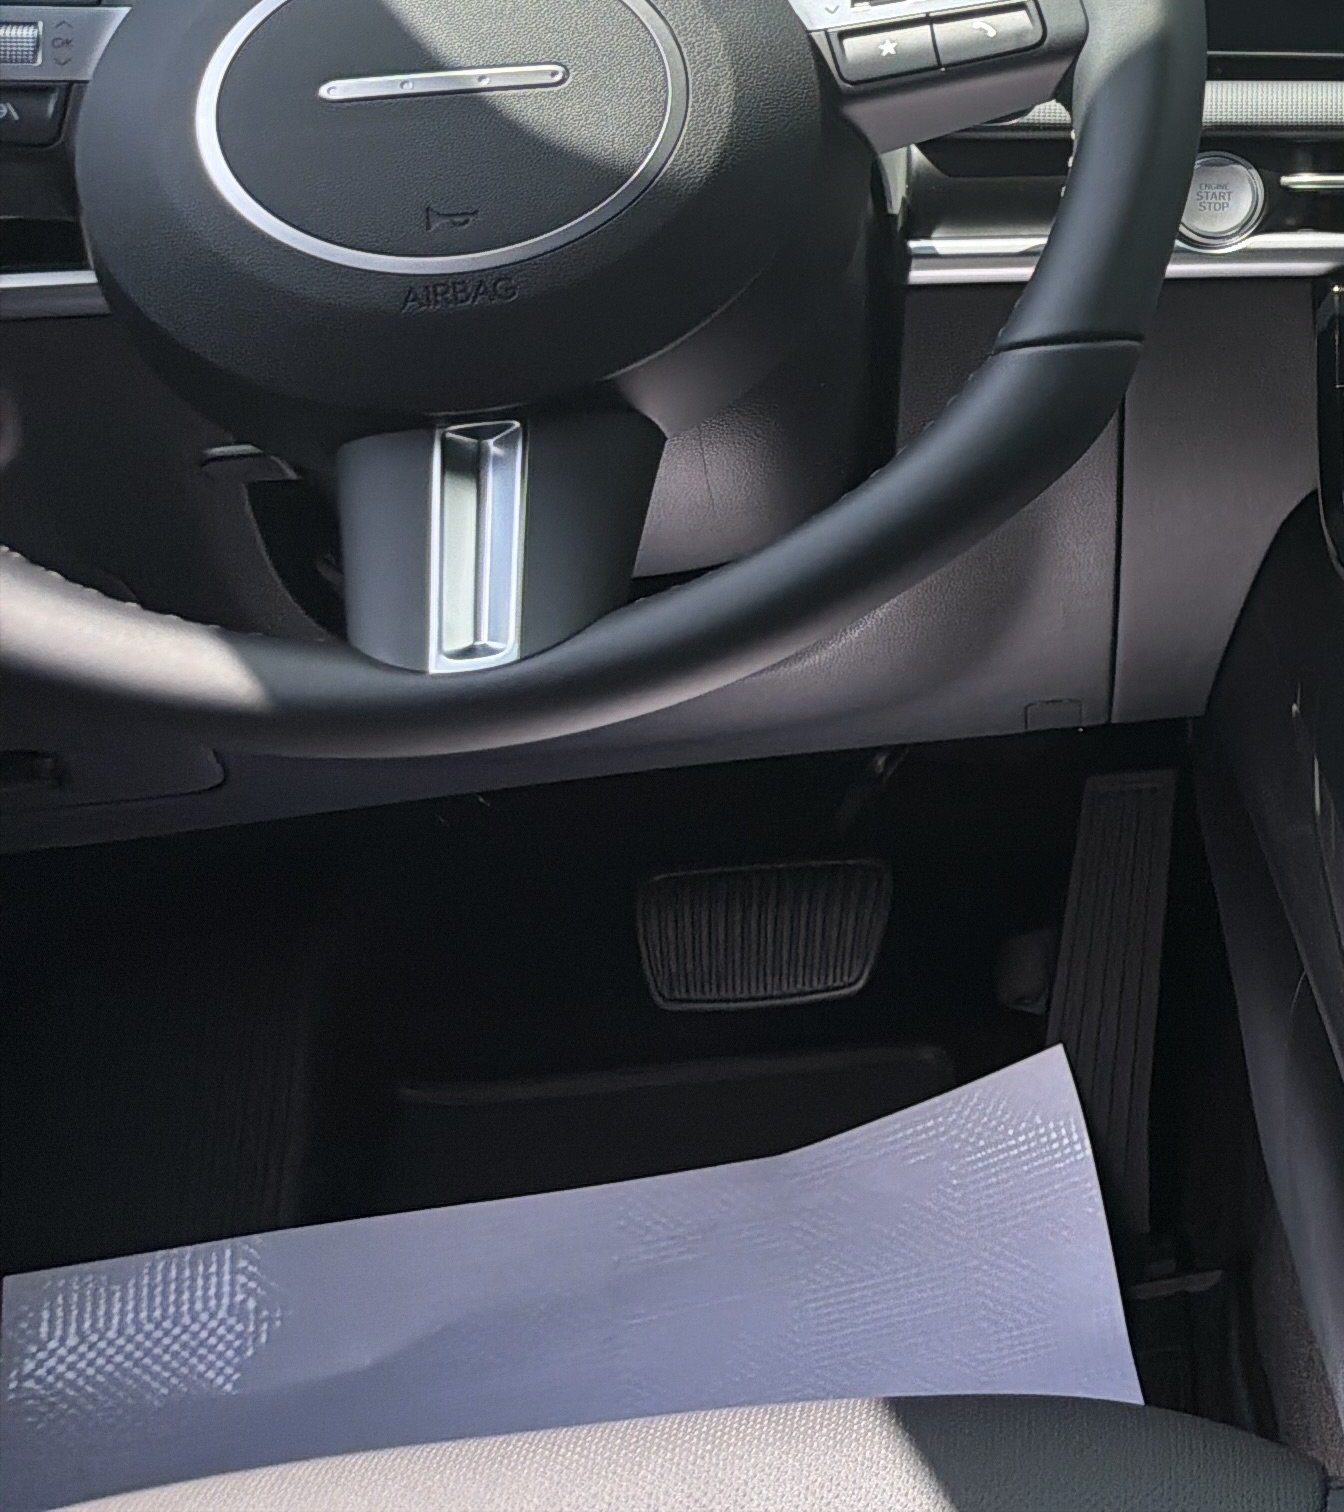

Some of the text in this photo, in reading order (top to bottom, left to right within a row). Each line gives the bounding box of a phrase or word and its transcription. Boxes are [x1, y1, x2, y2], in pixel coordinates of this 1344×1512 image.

[1196, 191, 1233, 201] START
[1198, 201, 1230, 212] STOP
[401, 278, 520, 314] AIRBAG
